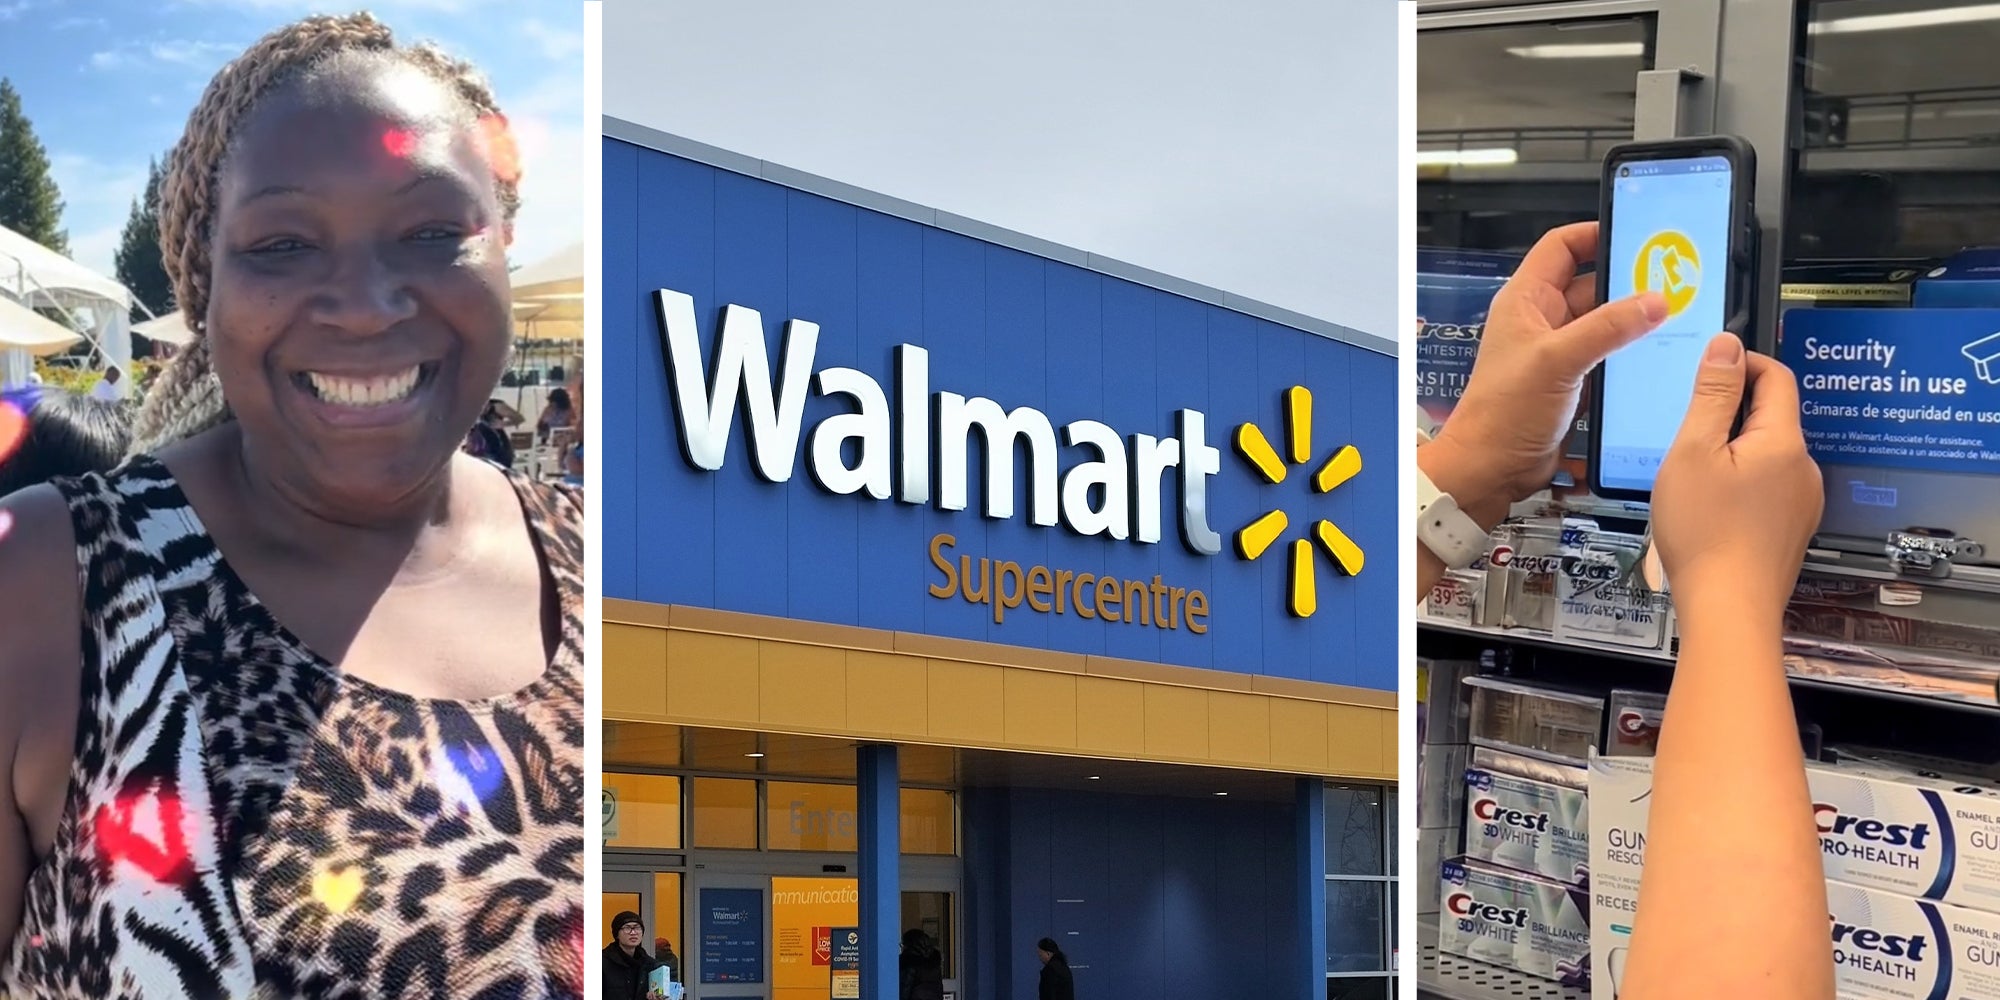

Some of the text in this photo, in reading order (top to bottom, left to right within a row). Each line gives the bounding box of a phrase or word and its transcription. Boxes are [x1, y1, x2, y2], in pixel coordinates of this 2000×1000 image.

[1417, 317, 1485, 341] rest
[1417, 344, 1476, 357] HITESTRI
[1804, 337, 1896, 369] Security
[1417, 370, 1471, 387] NSITI
[1803, 370, 1967, 395] cameras in use
[652, 288, 1221, 555] Walmart
[1801, 400, 2000, 424] Cámaras de seguridad en uso
[1815, 441, 1837, 452] favor,
[1838, 443, 1867, 453] solicita
[1868, 445, 1907, 455] asistencia
[1915, 449, 1927, 457] un
[1928, 449, 1965, 459] asociado
[1967, 450, 1978, 459] de
[1826, 432, 1840, 440] see
[1848, 431, 1881, 442] Walmart
[1883, 434, 1923, 444] Associate
[1924, 435, 1938, 444] for
[1939, 436, 1985, 447] assistance.
[928, 533, 1209, 634] Supercentre
[1474, 798, 1549, 832] Crest
[1812, 803, 1930, 850] Crest
[1956, 810, 1994, 824] ENAMEL
[1552, 826, 1588, 841] BRILLIA
[1970, 830, 2000, 851] GU
[713, 911, 740, 920] Walmart
[1447, 892, 1529, 928] Crest
[1531, 921, 1589, 944] BRILLIANCE
[1829, 914, 1927, 962] rest
[1953, 923, 1990, 939] ENAMEL
[1980, 940, 1998, 949] AND
